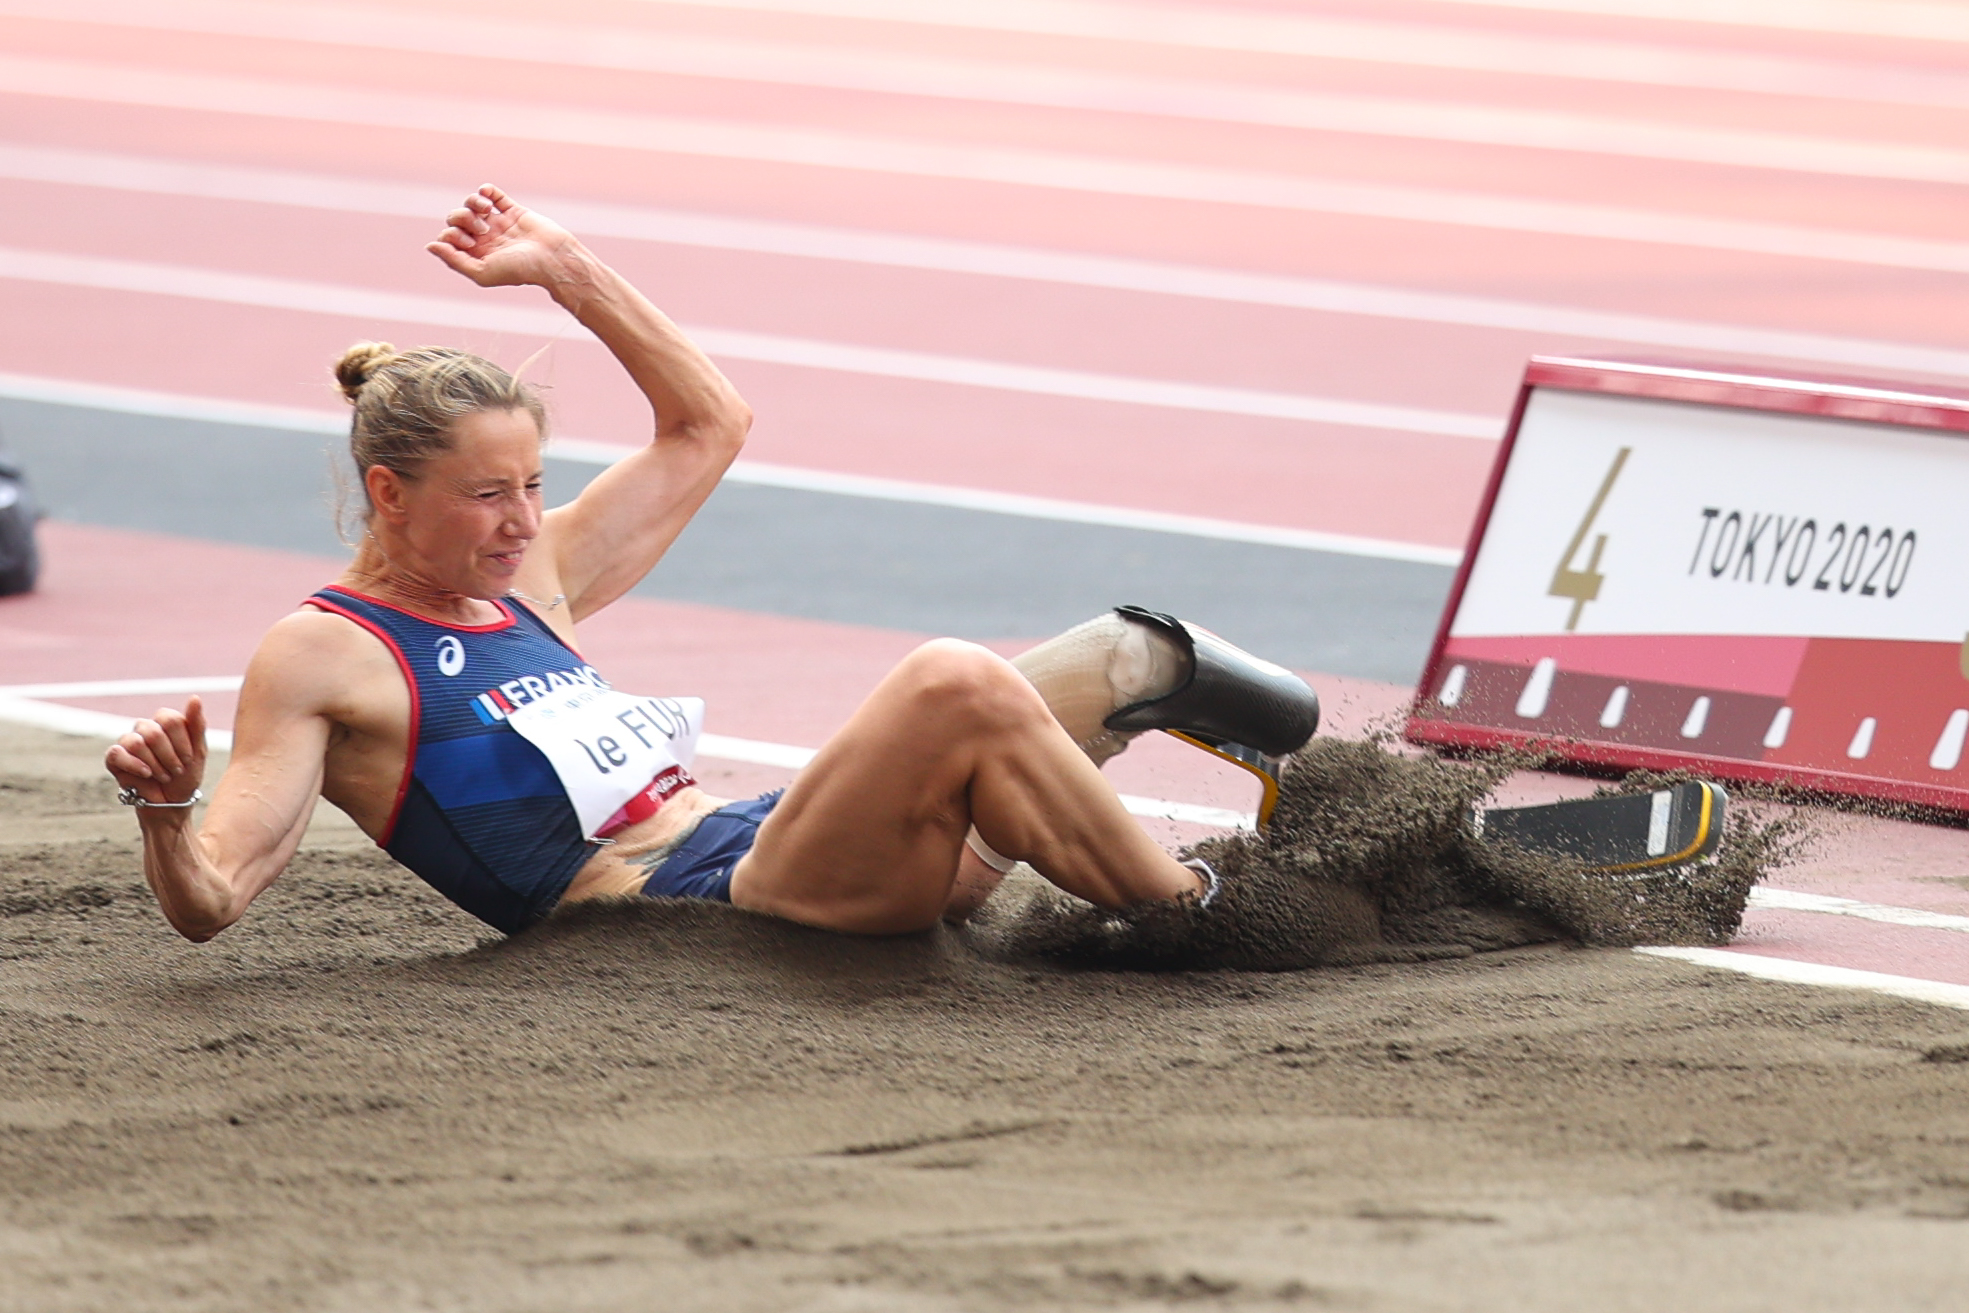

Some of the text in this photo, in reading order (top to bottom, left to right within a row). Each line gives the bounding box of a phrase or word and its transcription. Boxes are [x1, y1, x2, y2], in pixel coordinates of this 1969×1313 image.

[1547, 446, 1632, 632] 4
[1688, 506, 1918, 599] TOKYO 2020
[499, 665, 612, 710] FRANC
